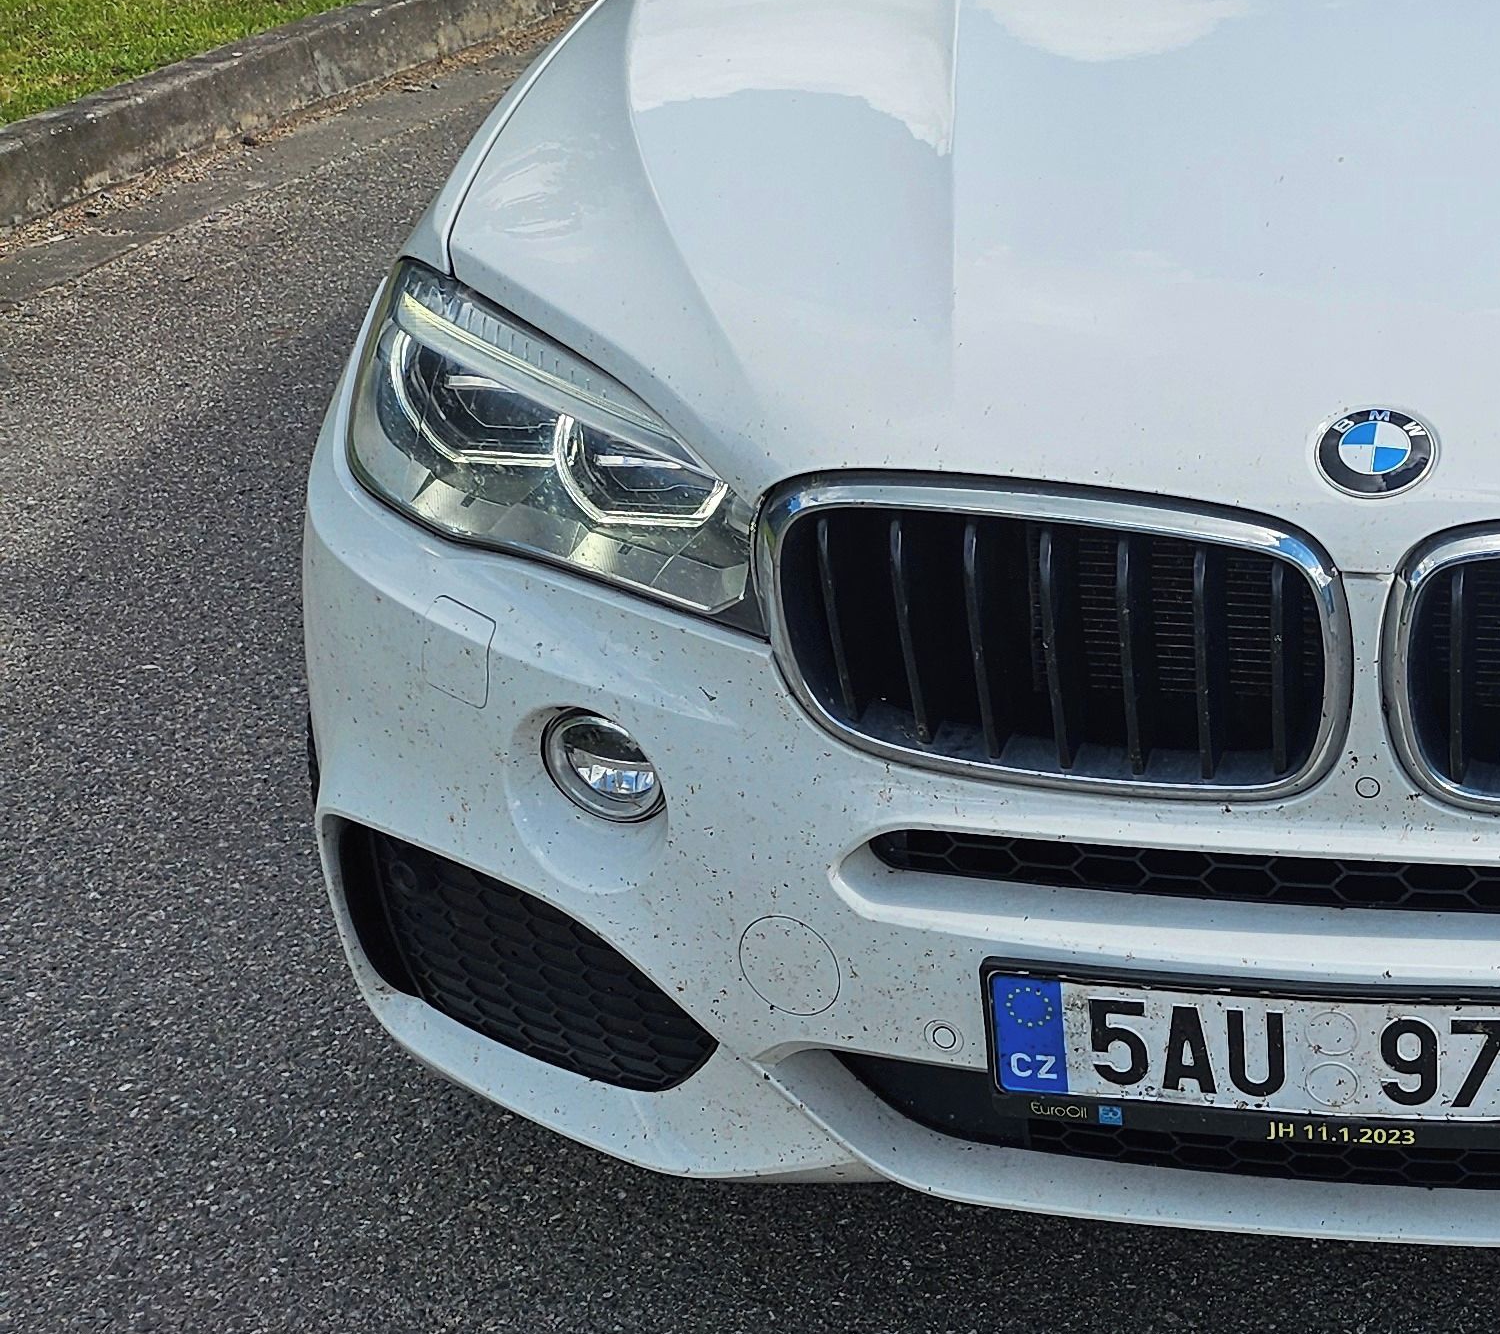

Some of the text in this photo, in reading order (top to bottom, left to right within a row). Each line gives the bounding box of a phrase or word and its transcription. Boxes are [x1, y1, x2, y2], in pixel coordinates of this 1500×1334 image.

[1331, 410, 1428, 438] BMW
[1088, 997, 1286, 1098] 5AU
[1010, 1052, 1058, 1080] CZ
[1030, 1101, 1088, 1119] EuroOil
[1266, 1121, 1416, 1145] JH 11.1.2023
